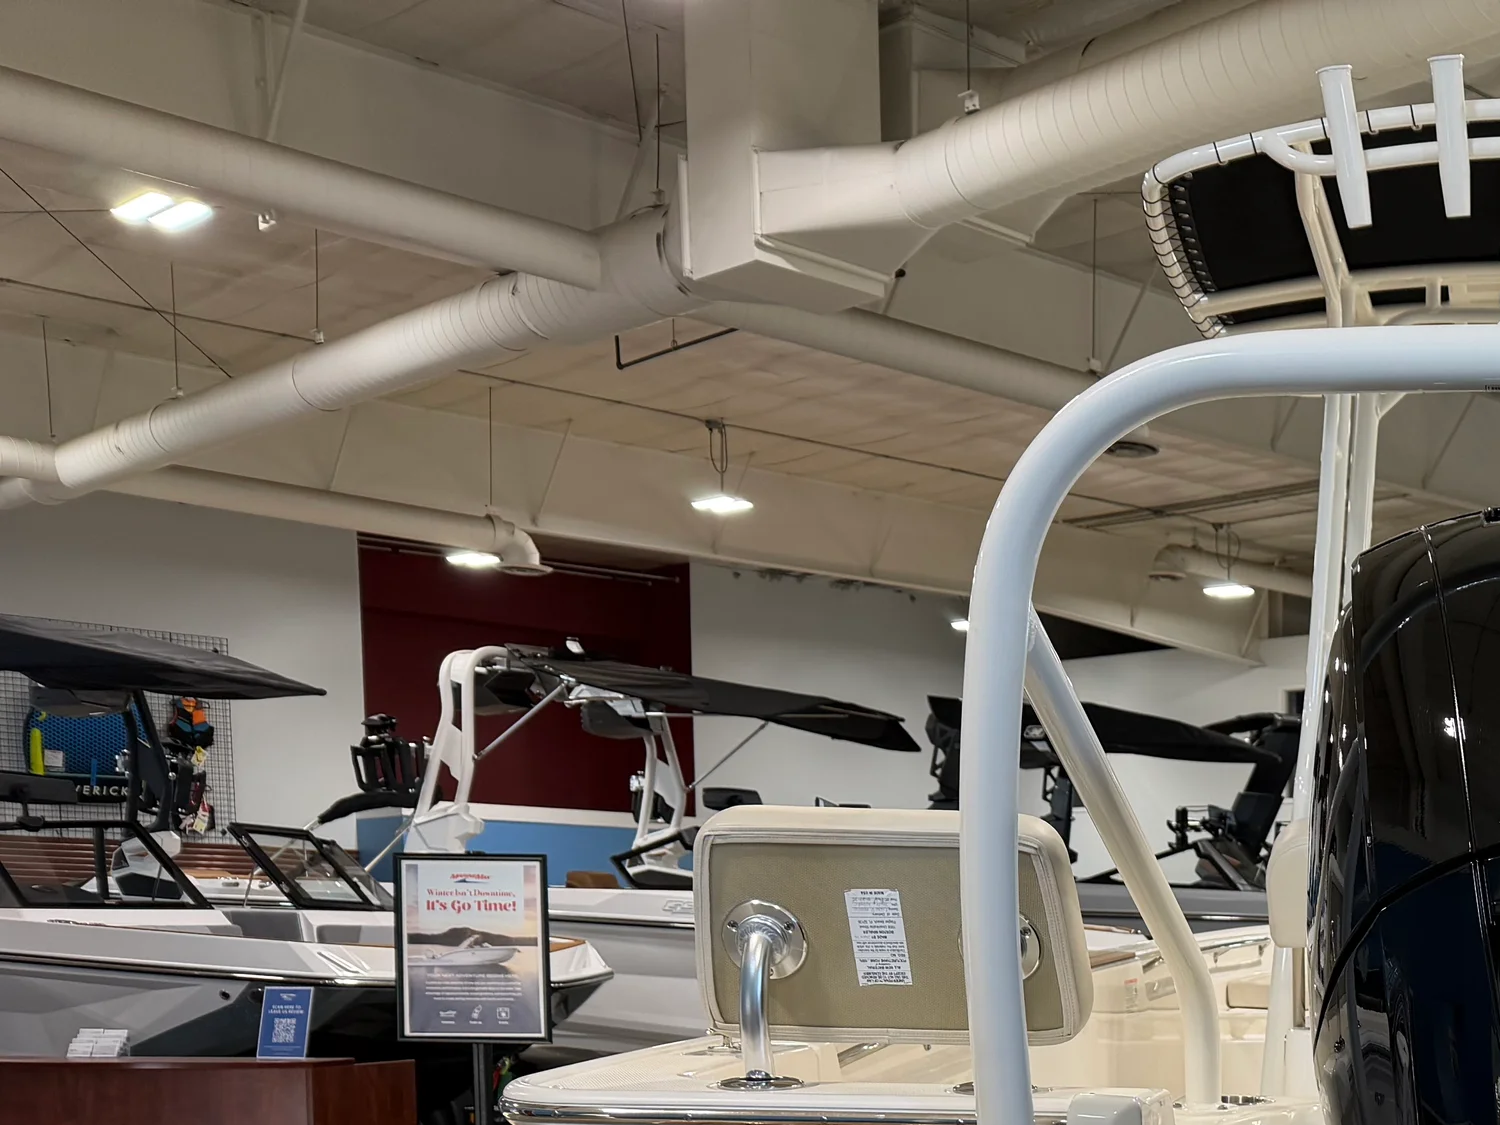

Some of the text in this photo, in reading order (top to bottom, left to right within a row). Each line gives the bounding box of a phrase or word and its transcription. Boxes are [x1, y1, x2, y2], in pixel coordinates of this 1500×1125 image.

[427, 888, 454, 896] Winter
[455, 888, 472, 897] Isn't
[426, 899, 516, 914] It's Go Time!
